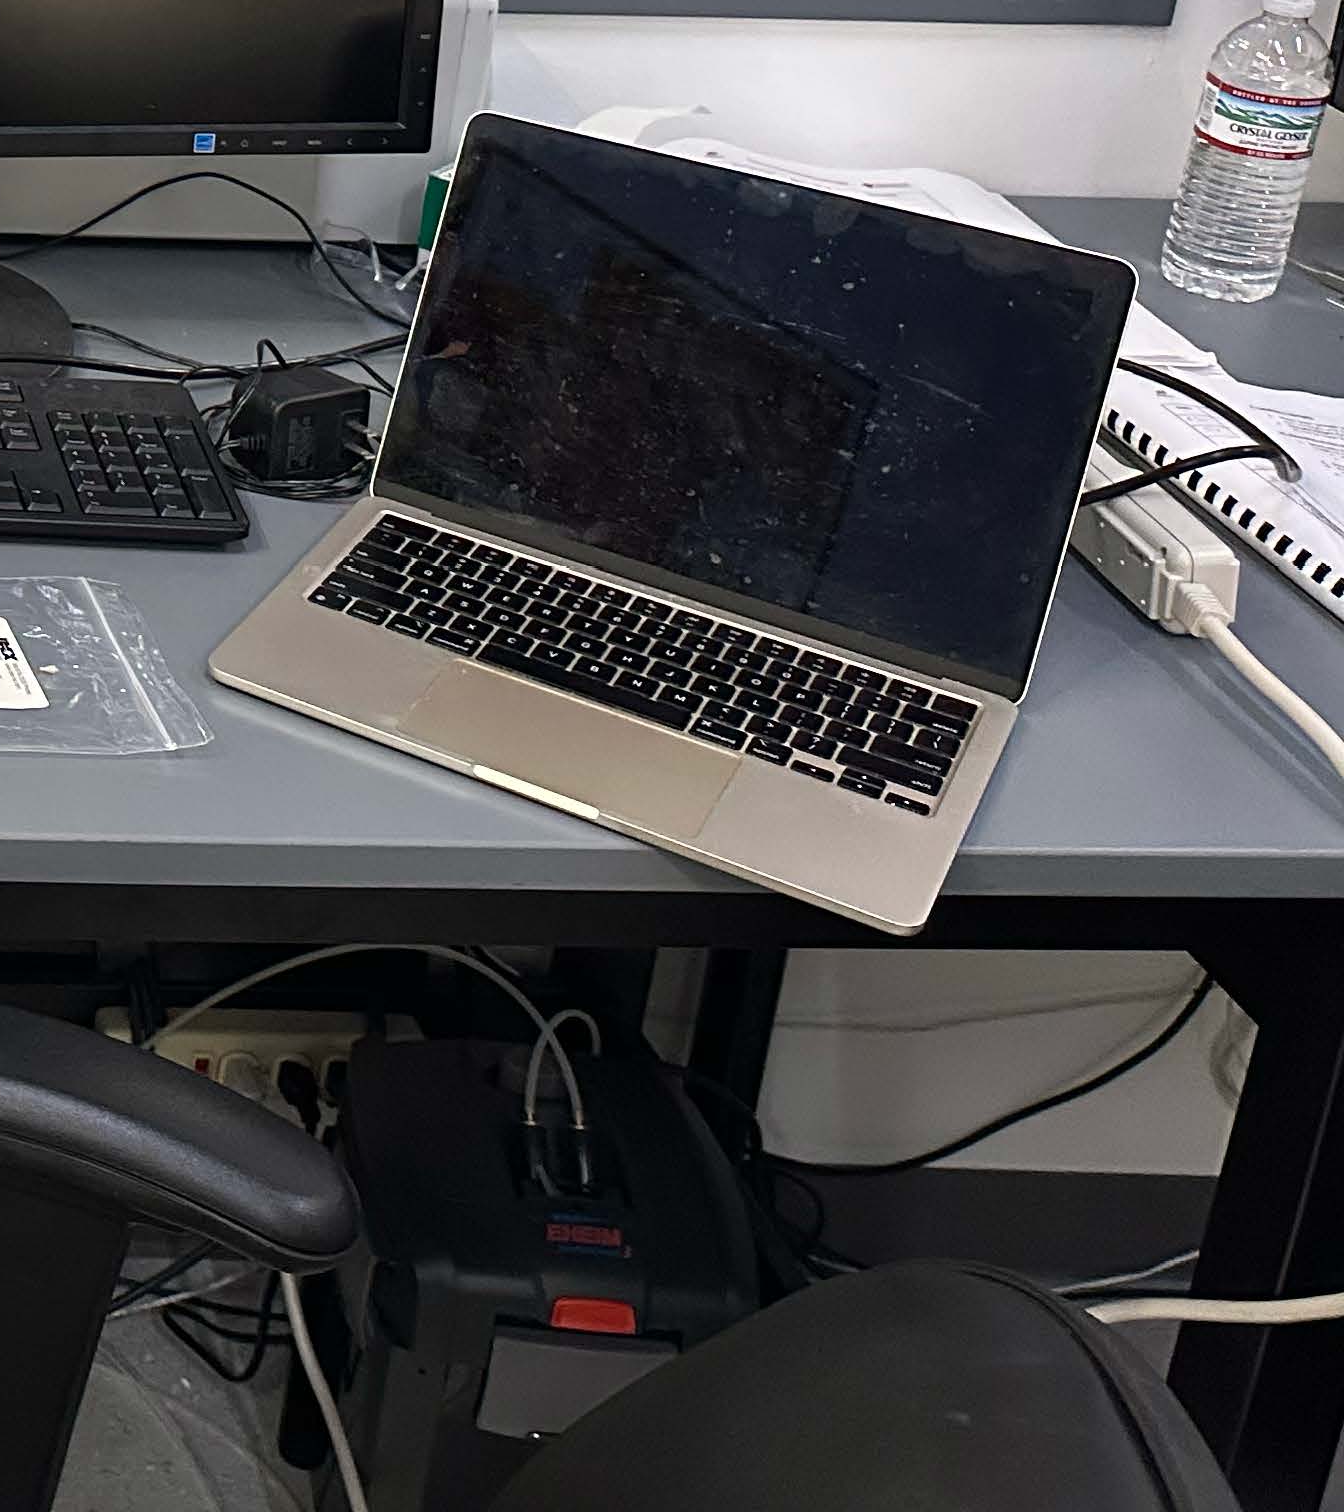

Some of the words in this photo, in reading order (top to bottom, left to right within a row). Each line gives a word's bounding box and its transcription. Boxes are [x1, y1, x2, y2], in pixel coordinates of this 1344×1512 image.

[1230, 123, 1272, 140] CRYSTAL
[462, 581, 474, 589] W
[665, 649, 676, 657] U
[548, 650, 559, 658] V
[632, 679, 643, 688] N
[673, 694, 687, 702] M
[622, 655, 633, 663] H
[708, 684, 719, 692] K
[752, 699, 761, 707] L
